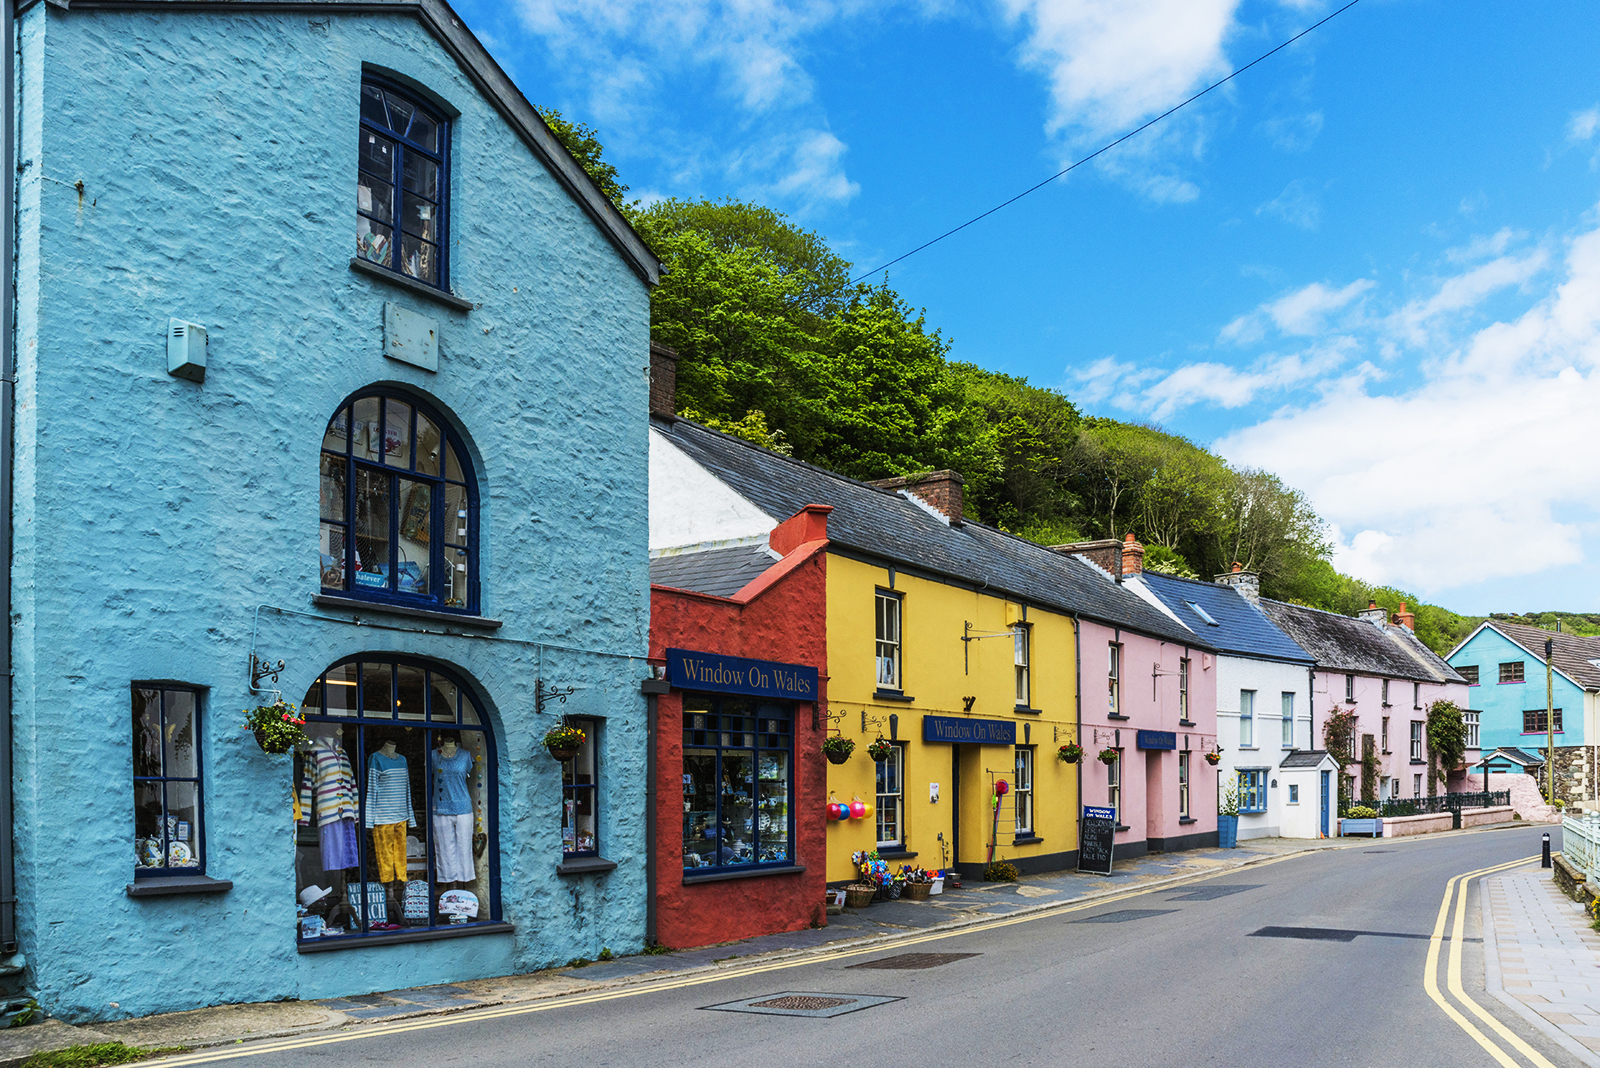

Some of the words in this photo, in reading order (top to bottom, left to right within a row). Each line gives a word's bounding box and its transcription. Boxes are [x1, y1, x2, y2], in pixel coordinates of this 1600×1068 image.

[683, 658, 745, 685] Window
[748, 666, 769, 688] On
[773, 670, 811, 693] Wales
[935, 720, 971, 738] Window
[973, 723, 986, 739] On
[988, 724, 1011, 741] Wales
